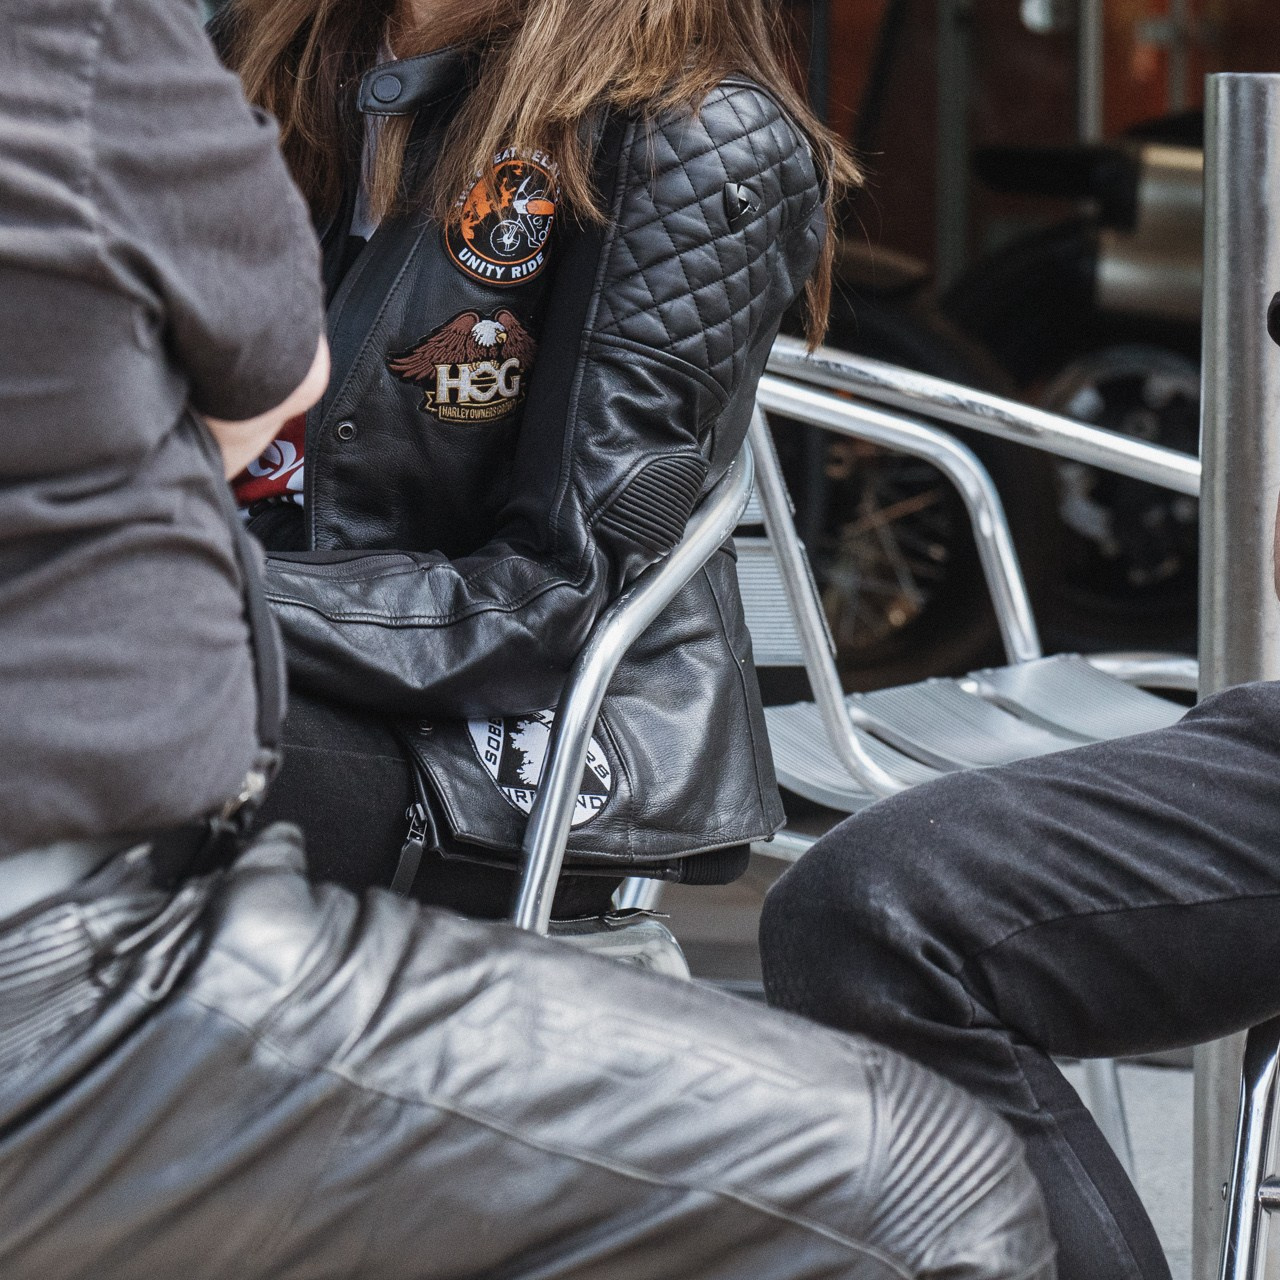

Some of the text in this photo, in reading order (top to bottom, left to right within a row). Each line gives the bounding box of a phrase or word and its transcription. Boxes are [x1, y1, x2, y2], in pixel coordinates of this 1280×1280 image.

[458, 248, 544, 279] UNITY RIDE
[435, 358, 520, 403] HOG
[442, 406, 470, 419] HARLEY
[470, 407, 497, 419] OWNERS
